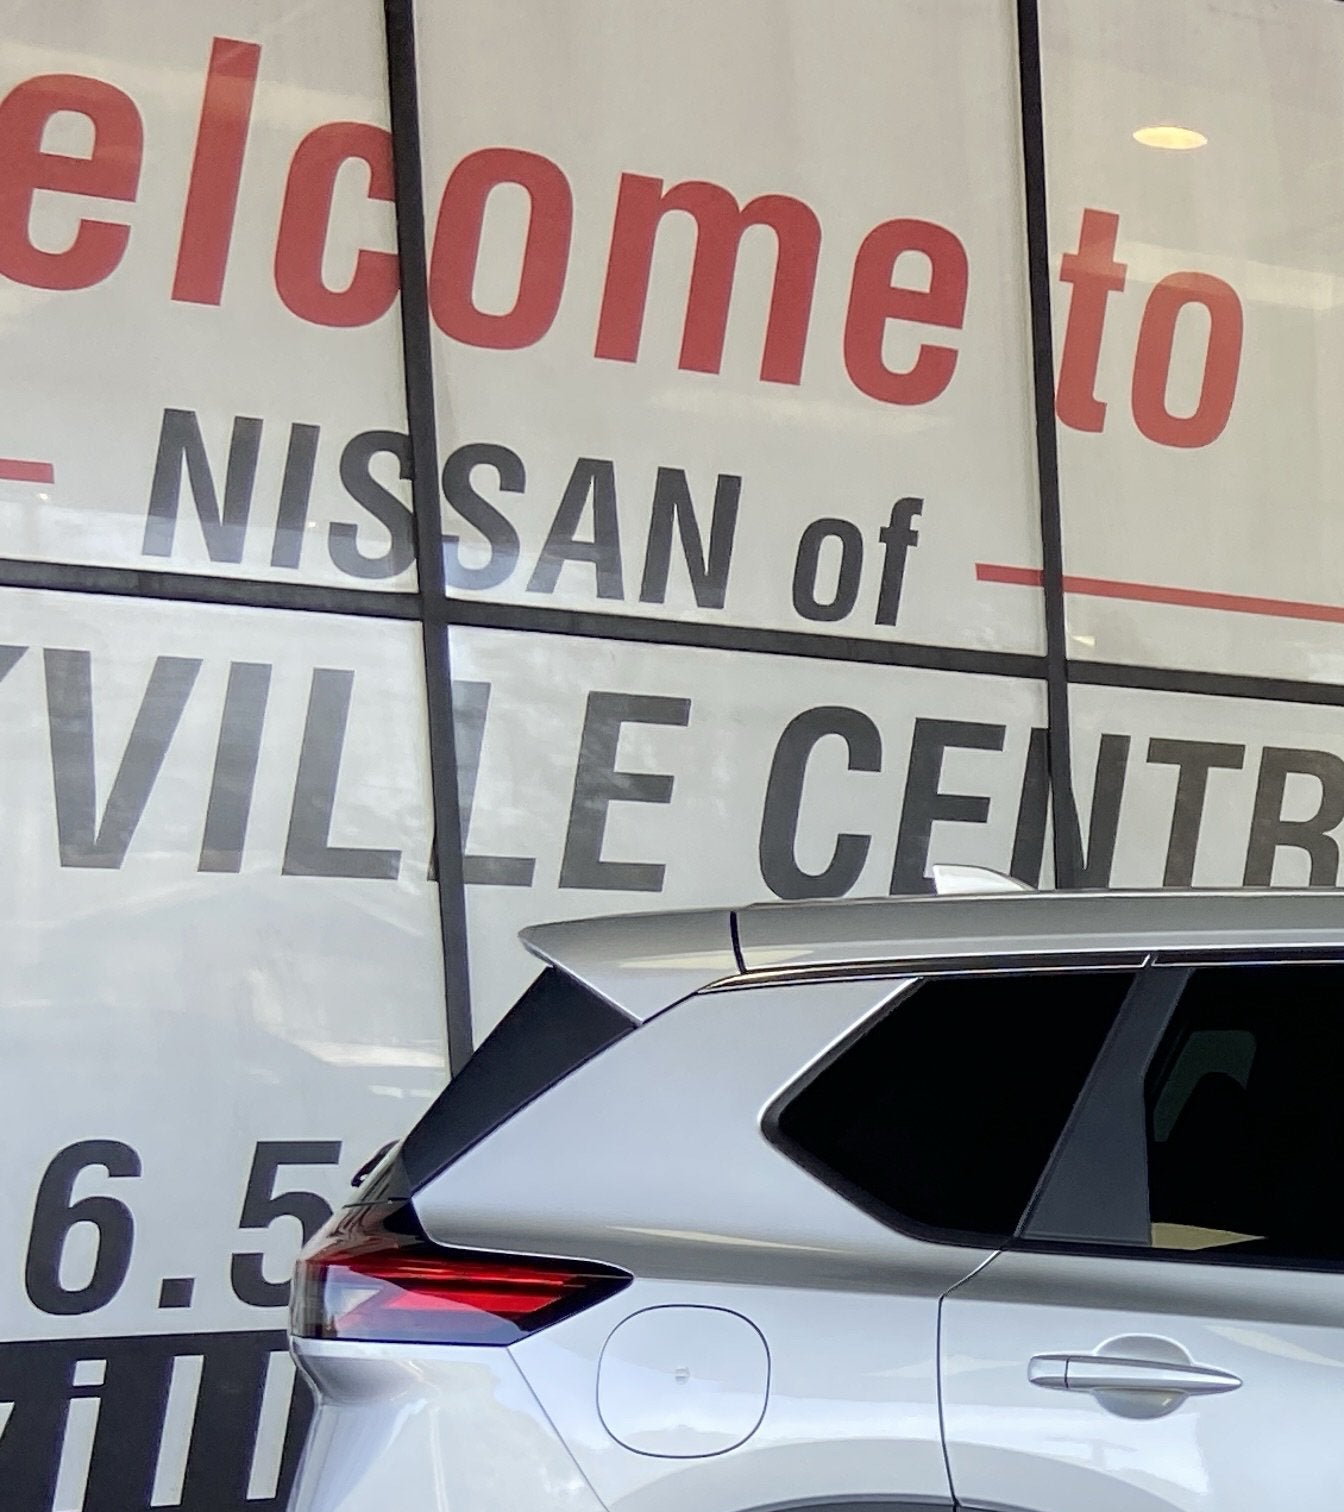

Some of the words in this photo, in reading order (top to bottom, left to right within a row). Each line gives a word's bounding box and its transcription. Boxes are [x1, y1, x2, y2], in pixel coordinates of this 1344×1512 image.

[1054, 207, 1244, 449] to
[140, 407, 742, 612] NISSAN
[791, 496, 924, 628] of
[0, 644, 692, 893] VILLE
